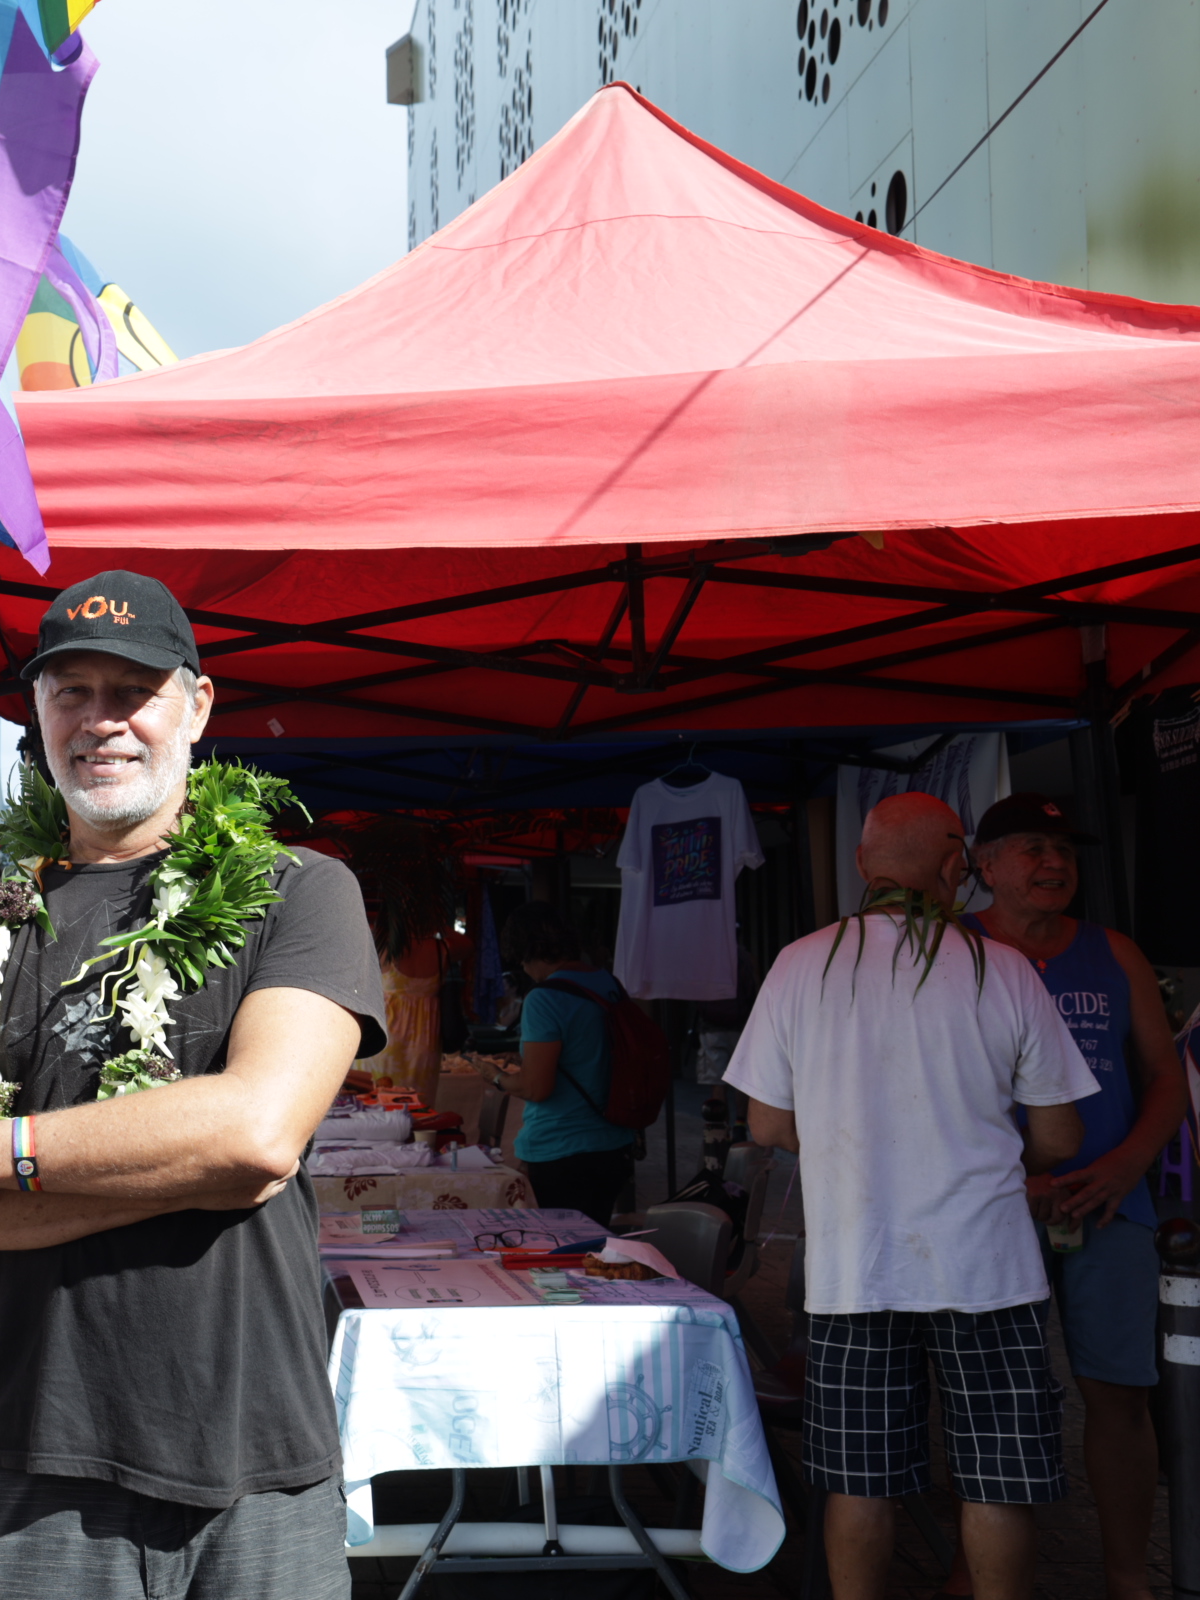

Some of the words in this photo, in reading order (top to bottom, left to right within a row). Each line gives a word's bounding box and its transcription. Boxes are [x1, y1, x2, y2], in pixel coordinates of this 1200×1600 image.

[663, 849, 711, 882] PRIDE
[1079, 1039, 1098, 1051] 767
[687, 1391, 714, 1455] Nautical
[705, 1420, 717, 1437] SEA
[714, 1381, 724, 1404] BOAT
